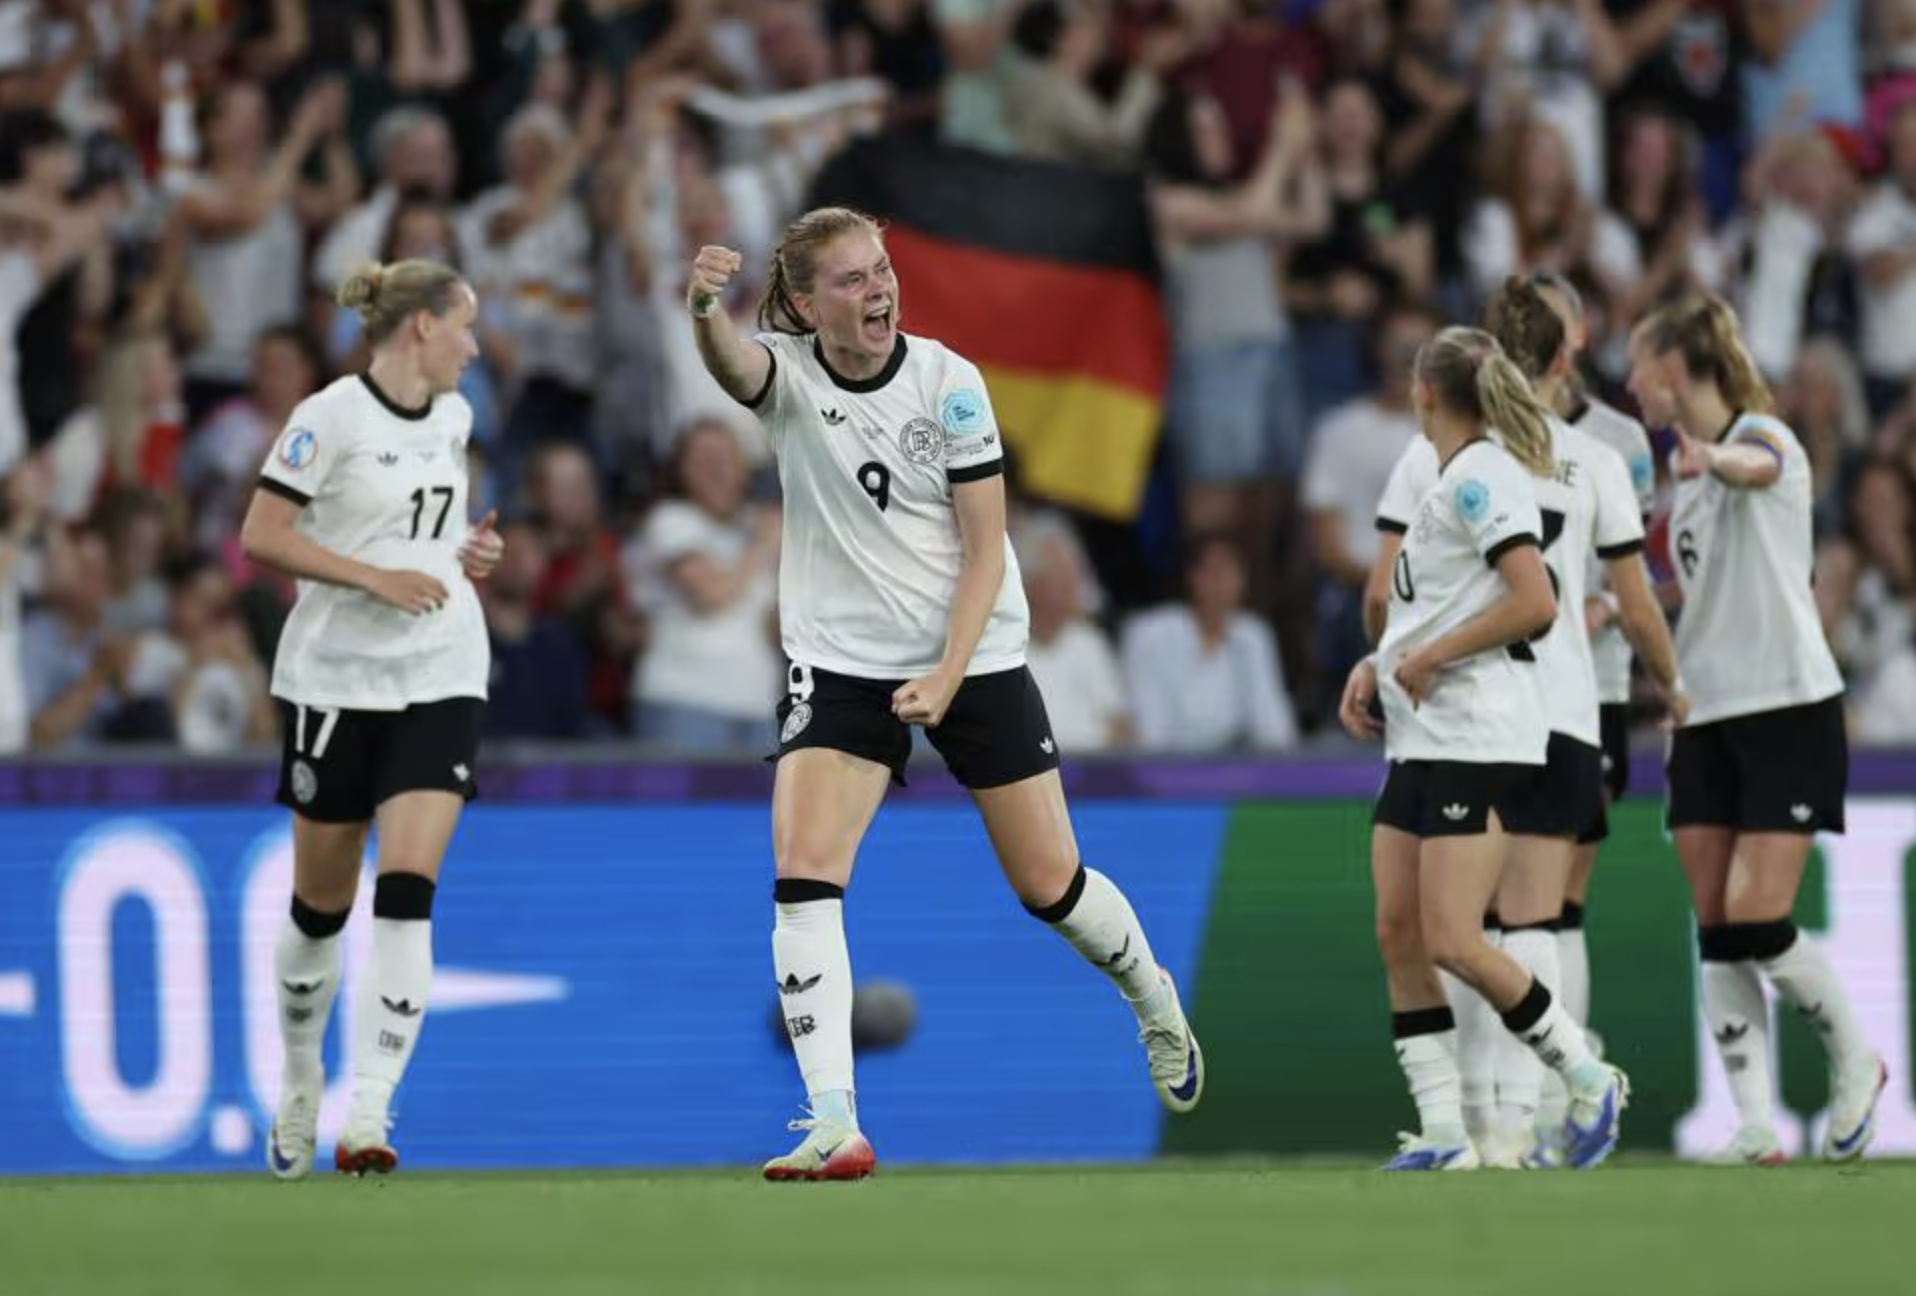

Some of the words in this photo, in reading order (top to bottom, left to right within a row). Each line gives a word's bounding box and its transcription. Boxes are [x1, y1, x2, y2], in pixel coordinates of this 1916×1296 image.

[410, 486, 454, 540] 17
[857, 461, 890, 512] 9
[1388, 549, 1414, 603] 0
[788, 660, 815, 705] 9
[295, 705, 341, 759] 17
